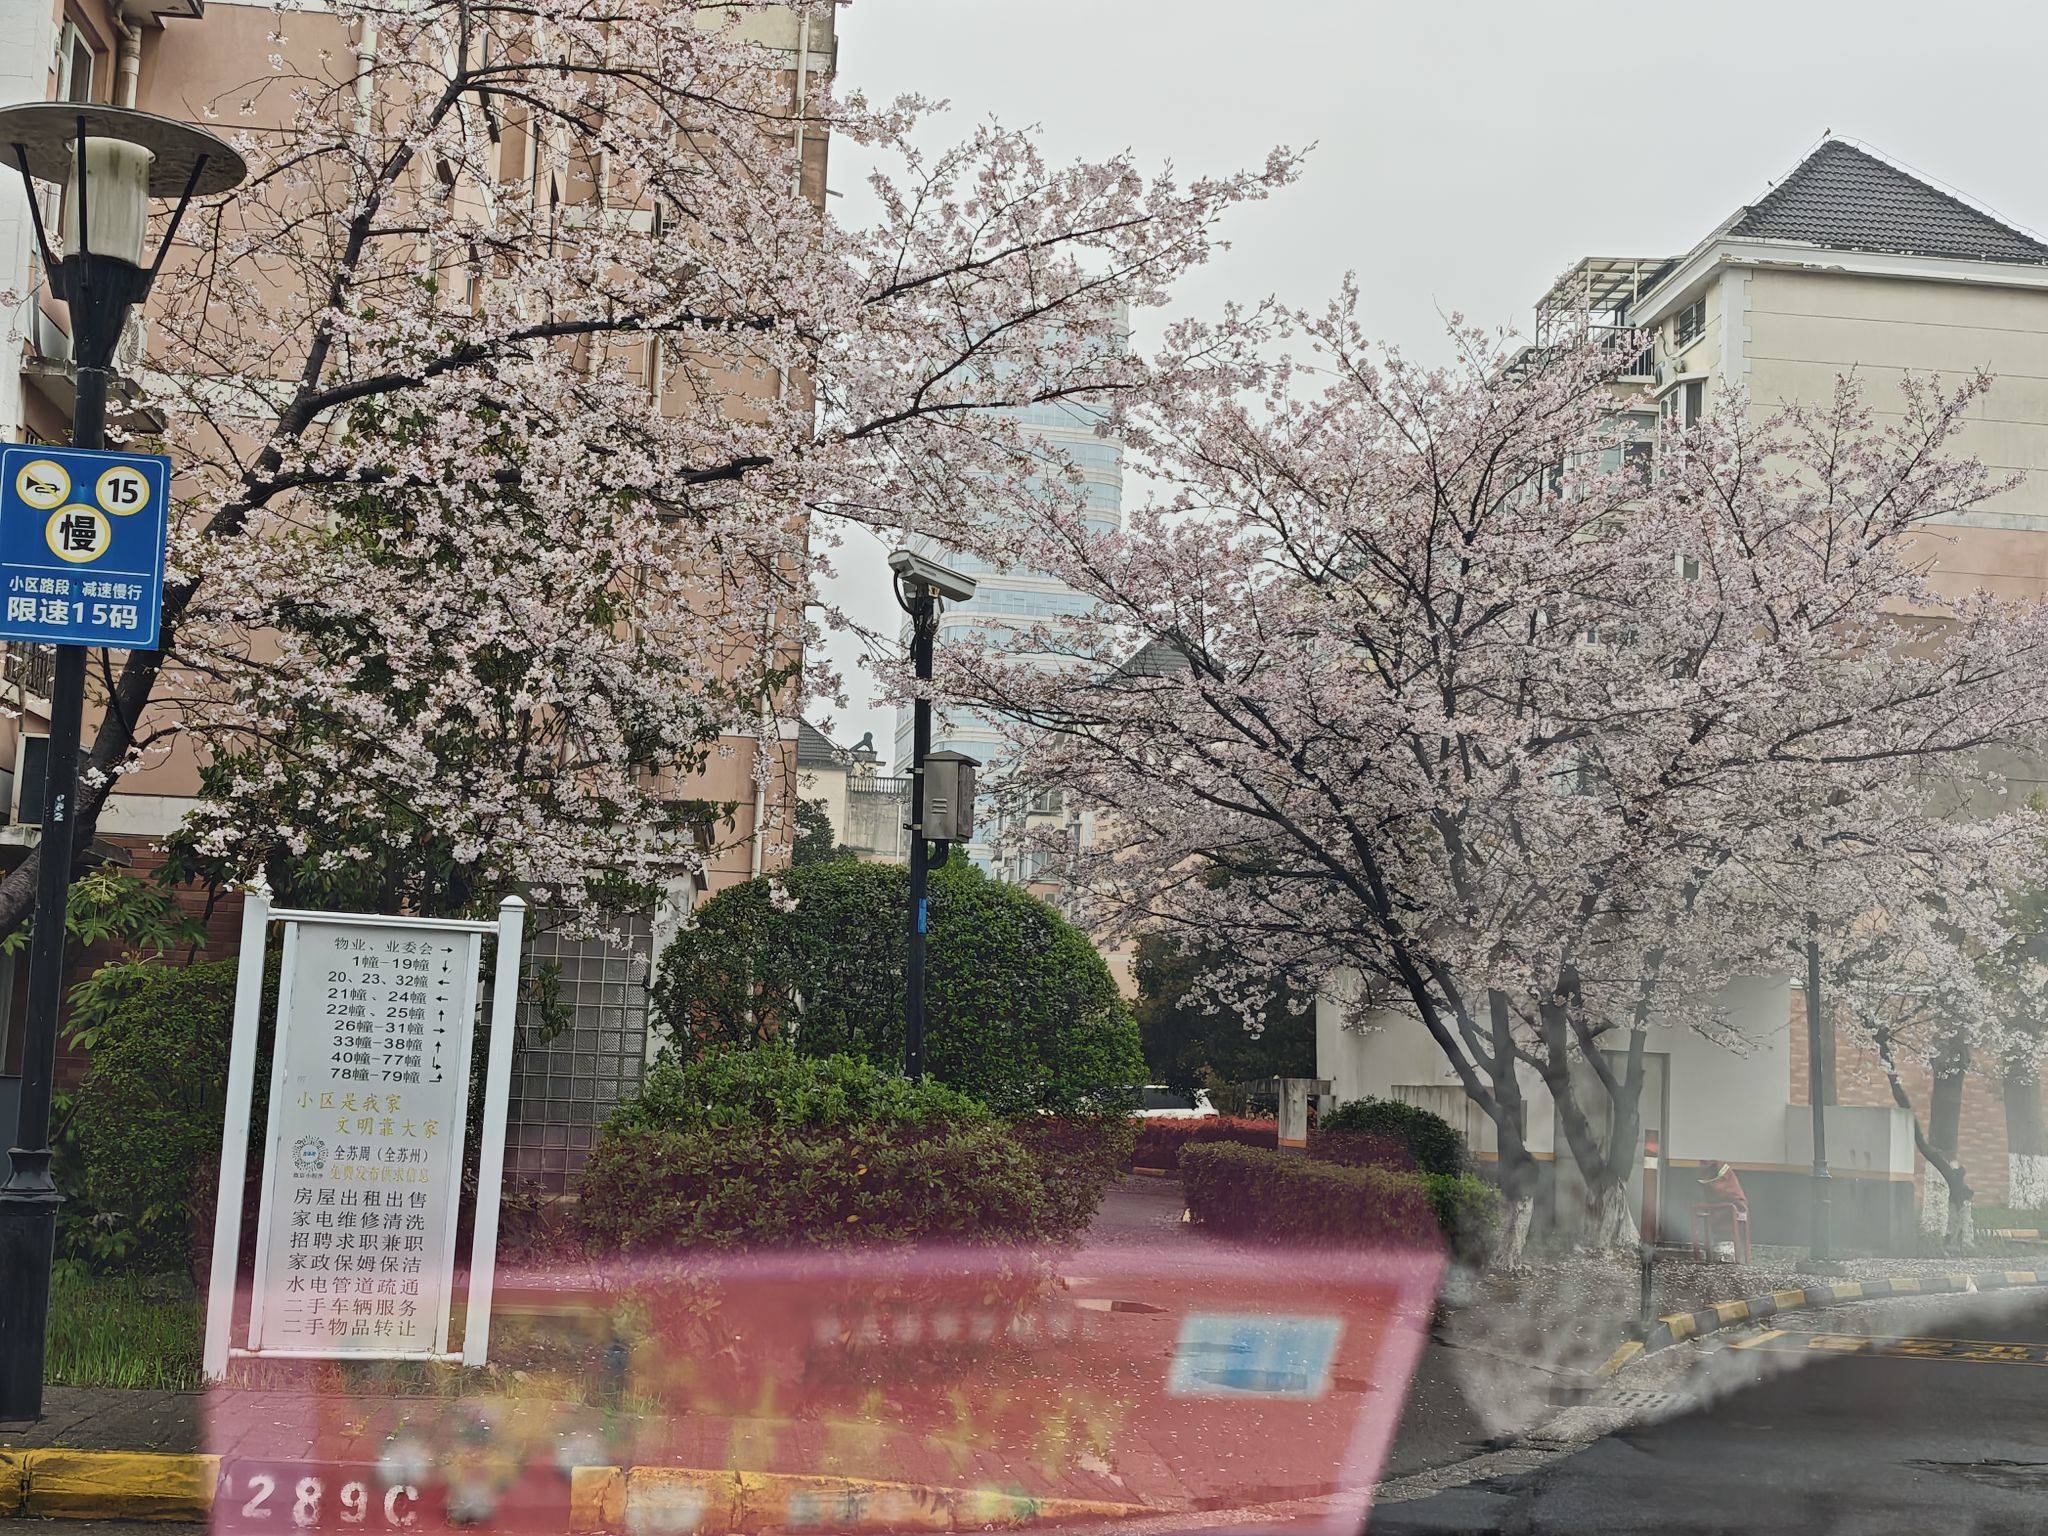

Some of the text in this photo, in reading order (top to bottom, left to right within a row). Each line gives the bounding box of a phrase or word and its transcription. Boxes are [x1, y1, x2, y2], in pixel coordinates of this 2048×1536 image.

[108, 478, 138, 503] 15
[60, 514, 96, 552] 慢
[9, 576, 143, 600] 小区路段 减速慢行
[7, 596, 138, 630] 限速15码
[334, 936, 433, 955] 物业、业委会
[352, 956, 430, 972] 1幢-19幢
[328, 971, 428, 988] 20、23、32幢
[327, 988, 427, 1004] 21幢、24幢
[326, 1004, 425, 1020] 22幢、25幢
[334, 1020, 424, 1035] 26幢-31幢
[333, 1036, 423, 1051] 33幢-38幢
[331, 1052, 422, 1067] 40幢-77幢
[330, 1068, 420, 1084] 78幢-79幢
[297, 1091, 401, 1113] 小区是我家
[335, 1116, 440, 1139] 文明靠大家
[292, 1187, 427, 1209] 房屋出租出售
[291, 1210, 425, 1231] 家电维修清洗
[289, 1231, 423, 1252] 招聘求职兼职
[287, 1253, 422, 1273] 家政保姆保洁
[285, 1275, 419, 1296] 水电管道疏通
[284, 1297, 417, 1317] 二手车辆服务
[282, 1318, 416, 1337] 二手物品转让
